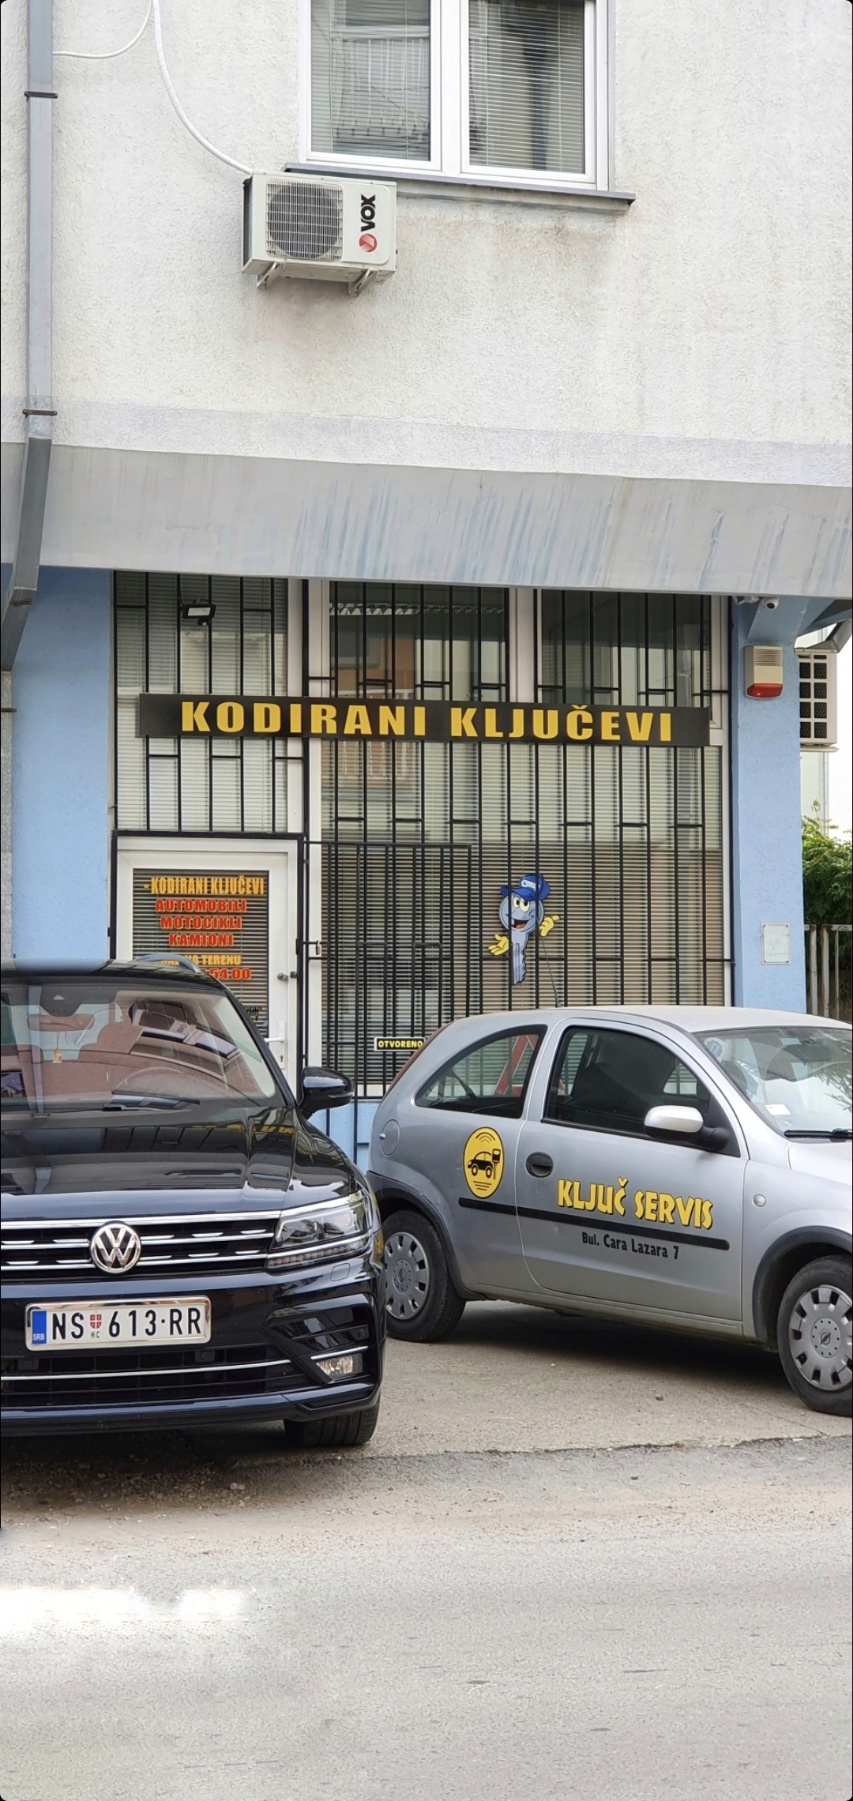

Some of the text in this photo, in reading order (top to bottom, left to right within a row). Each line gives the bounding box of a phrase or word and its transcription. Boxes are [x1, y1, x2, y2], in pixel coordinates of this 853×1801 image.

[360, 194, 376, 232] VOX
[181, 701, 673, 742] KODIRANI KLJUČEVI
[210, 875, 265, 895] KLJUČEVI
[154, 898, 247, 913] AUTOMOBILI
[160, 915, 242, 930] MOTOCIKLI
[168, 933, 234, 947] KAMIONI
[202, 954, 242, 966] TERENU
[377, 1040, 423, 1049] OTVORENO
[557, 1177, 713, 1230] KLJUČ SERVIS
[581, 1232, 680, 1260] Bul. Cara Lazara 7
[52, 1311, 84, 1340] NS
[32, 1332, 45, 1341] SRB
